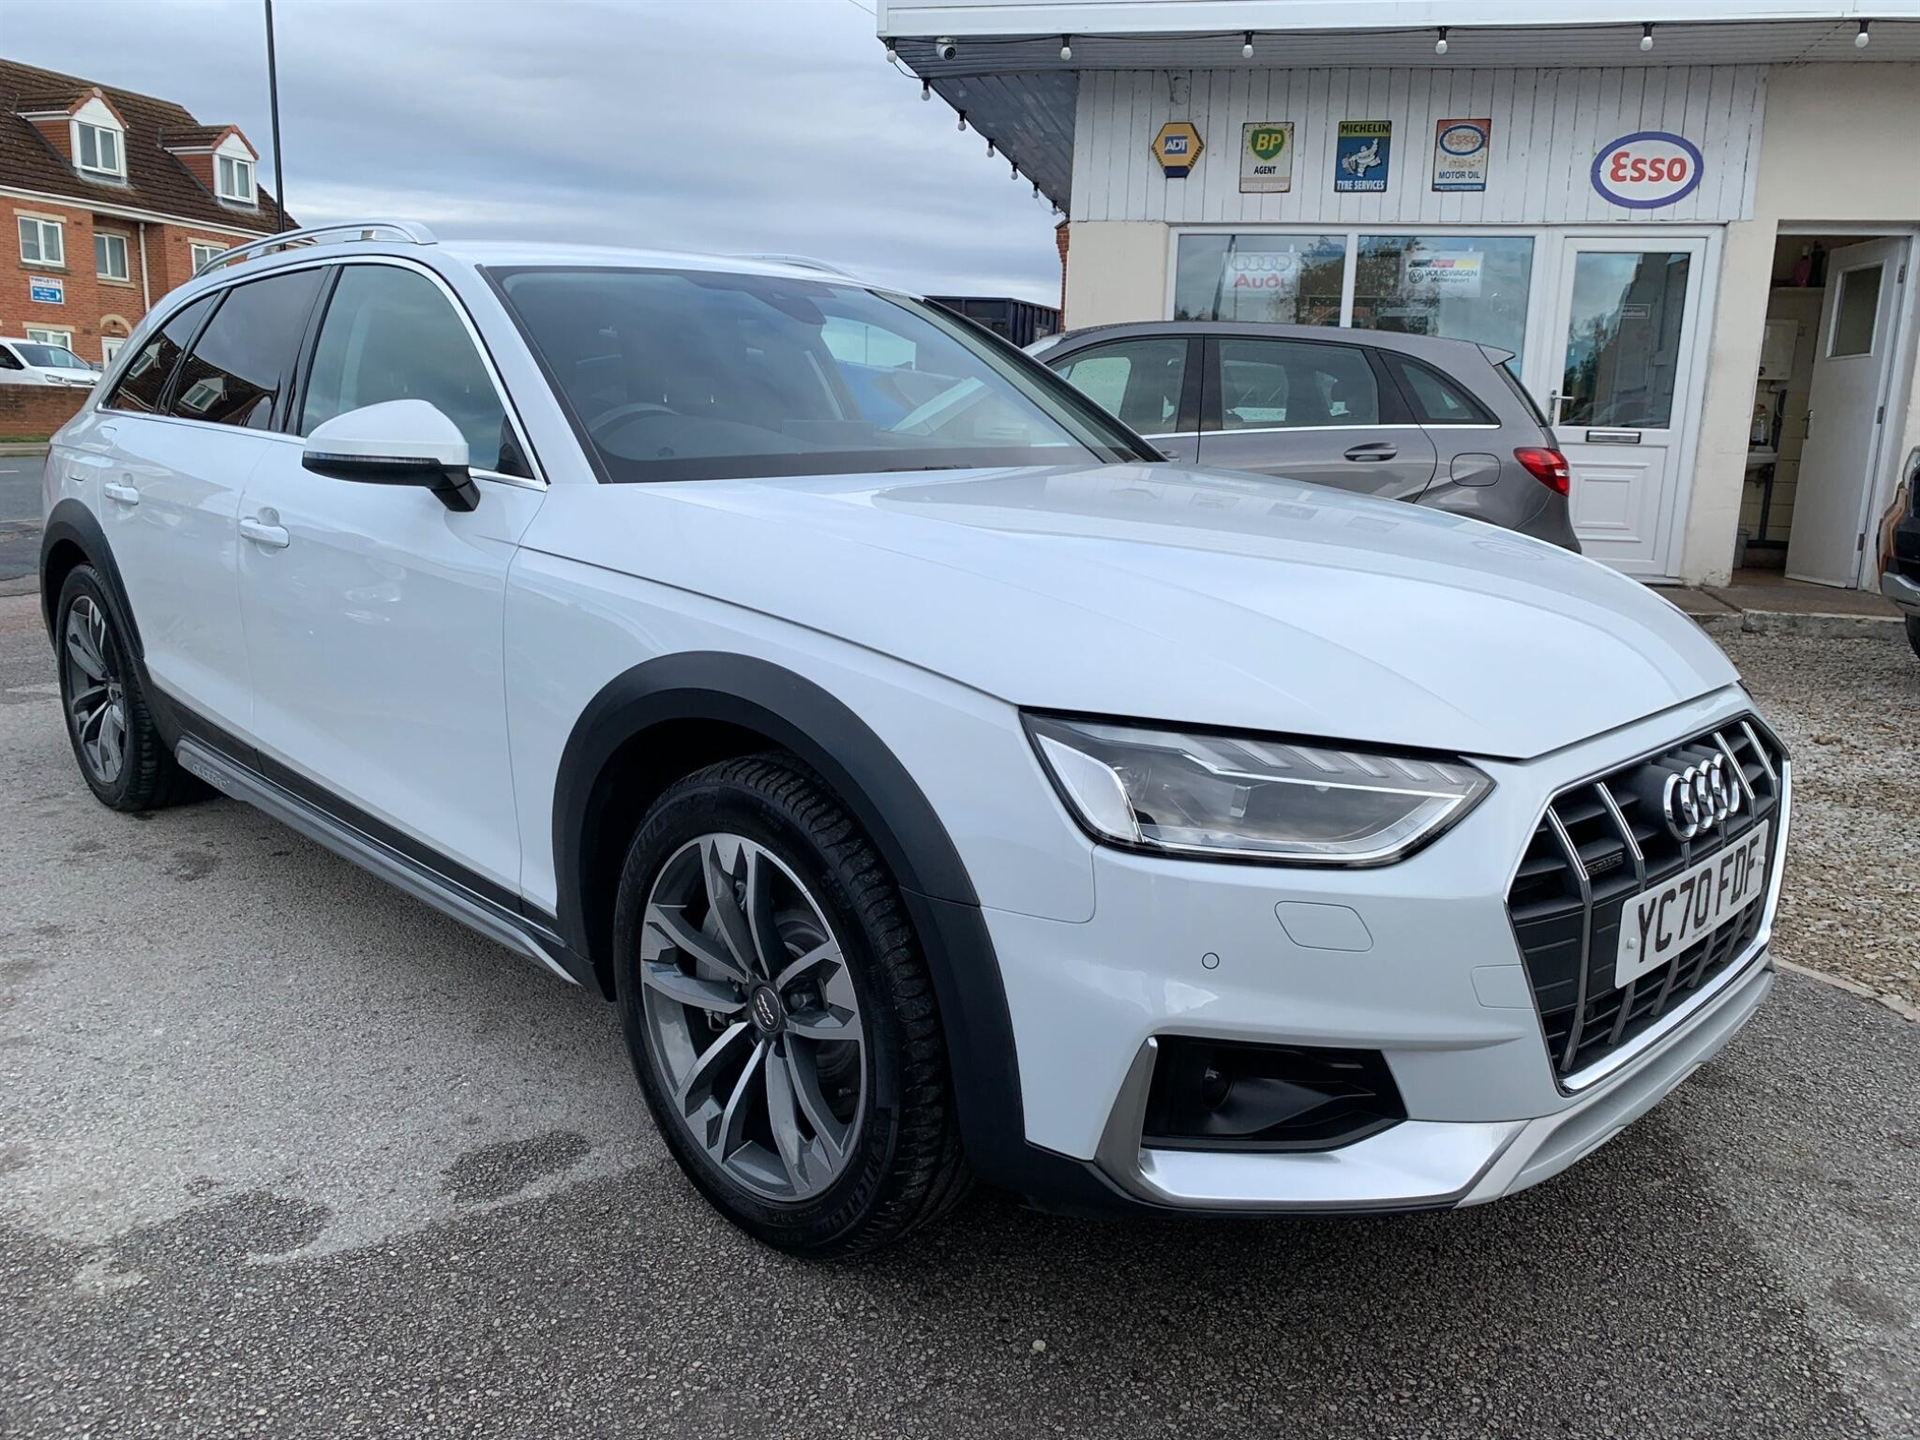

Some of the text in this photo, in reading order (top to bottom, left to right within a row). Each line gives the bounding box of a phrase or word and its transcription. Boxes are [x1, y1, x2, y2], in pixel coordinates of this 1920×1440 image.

[1341, 122, 1389, 135] MICHELIN
[1164, 138, 1188, 151] ADT
[1255, 133, 1282, 151] BP
[1253, 166, 1277, 175] AGENT
[1439, 171, 1480, 179] MOTOR OIL
[1337, 180, 1385, 191] TYRE SERVICES
[1424, 269, 1478, 277] VOLKSWAGEN
[1233, 273, 1286, 289] Audi
[1638, 834, 1759, 963] YC70 FDF
